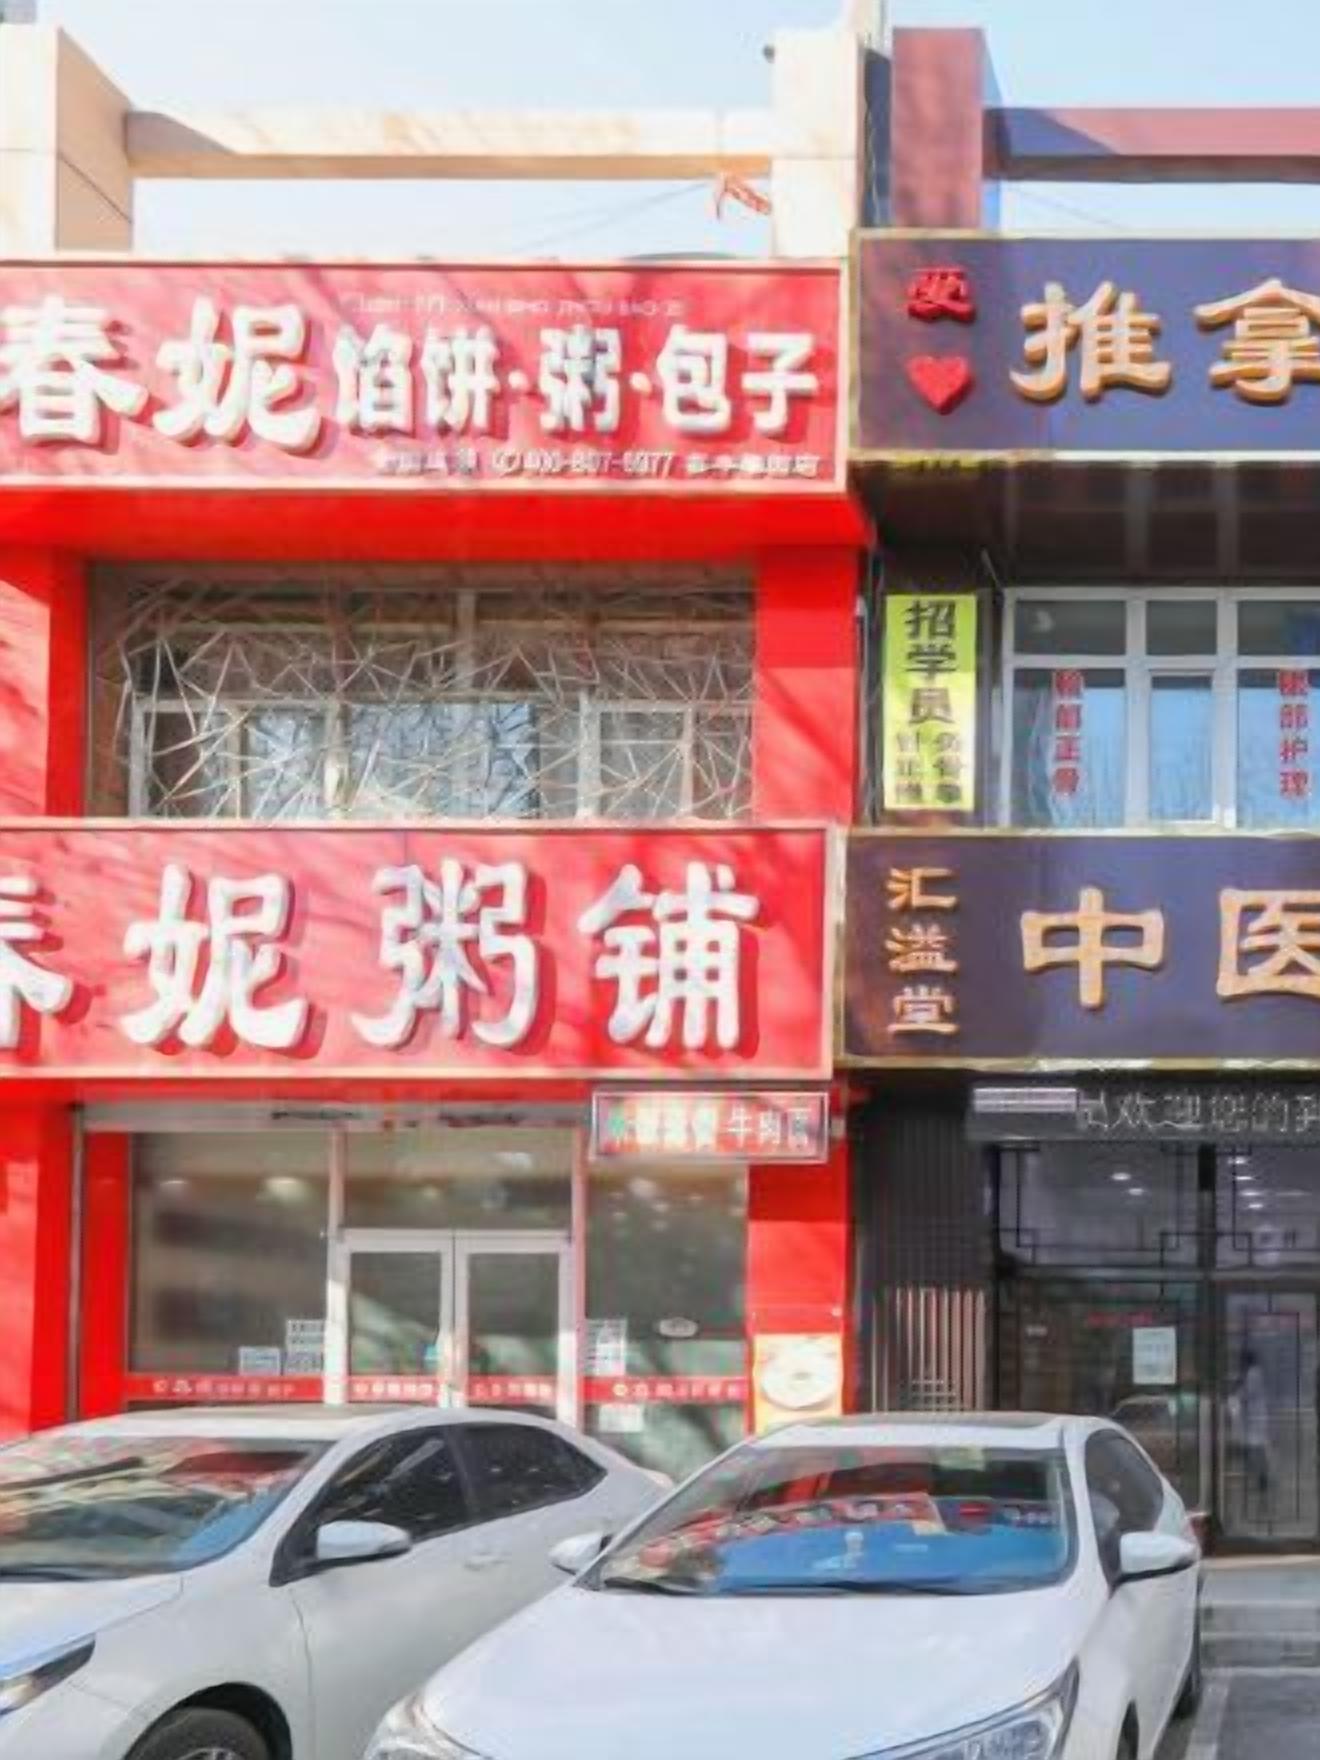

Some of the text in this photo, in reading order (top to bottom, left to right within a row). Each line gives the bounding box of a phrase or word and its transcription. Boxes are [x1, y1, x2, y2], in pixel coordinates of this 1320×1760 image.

[0, 296, 321, 450] 春妮
[903, 599, 957, 725] 招学员
[885, 866, 959, 1036] 汇溢堂
